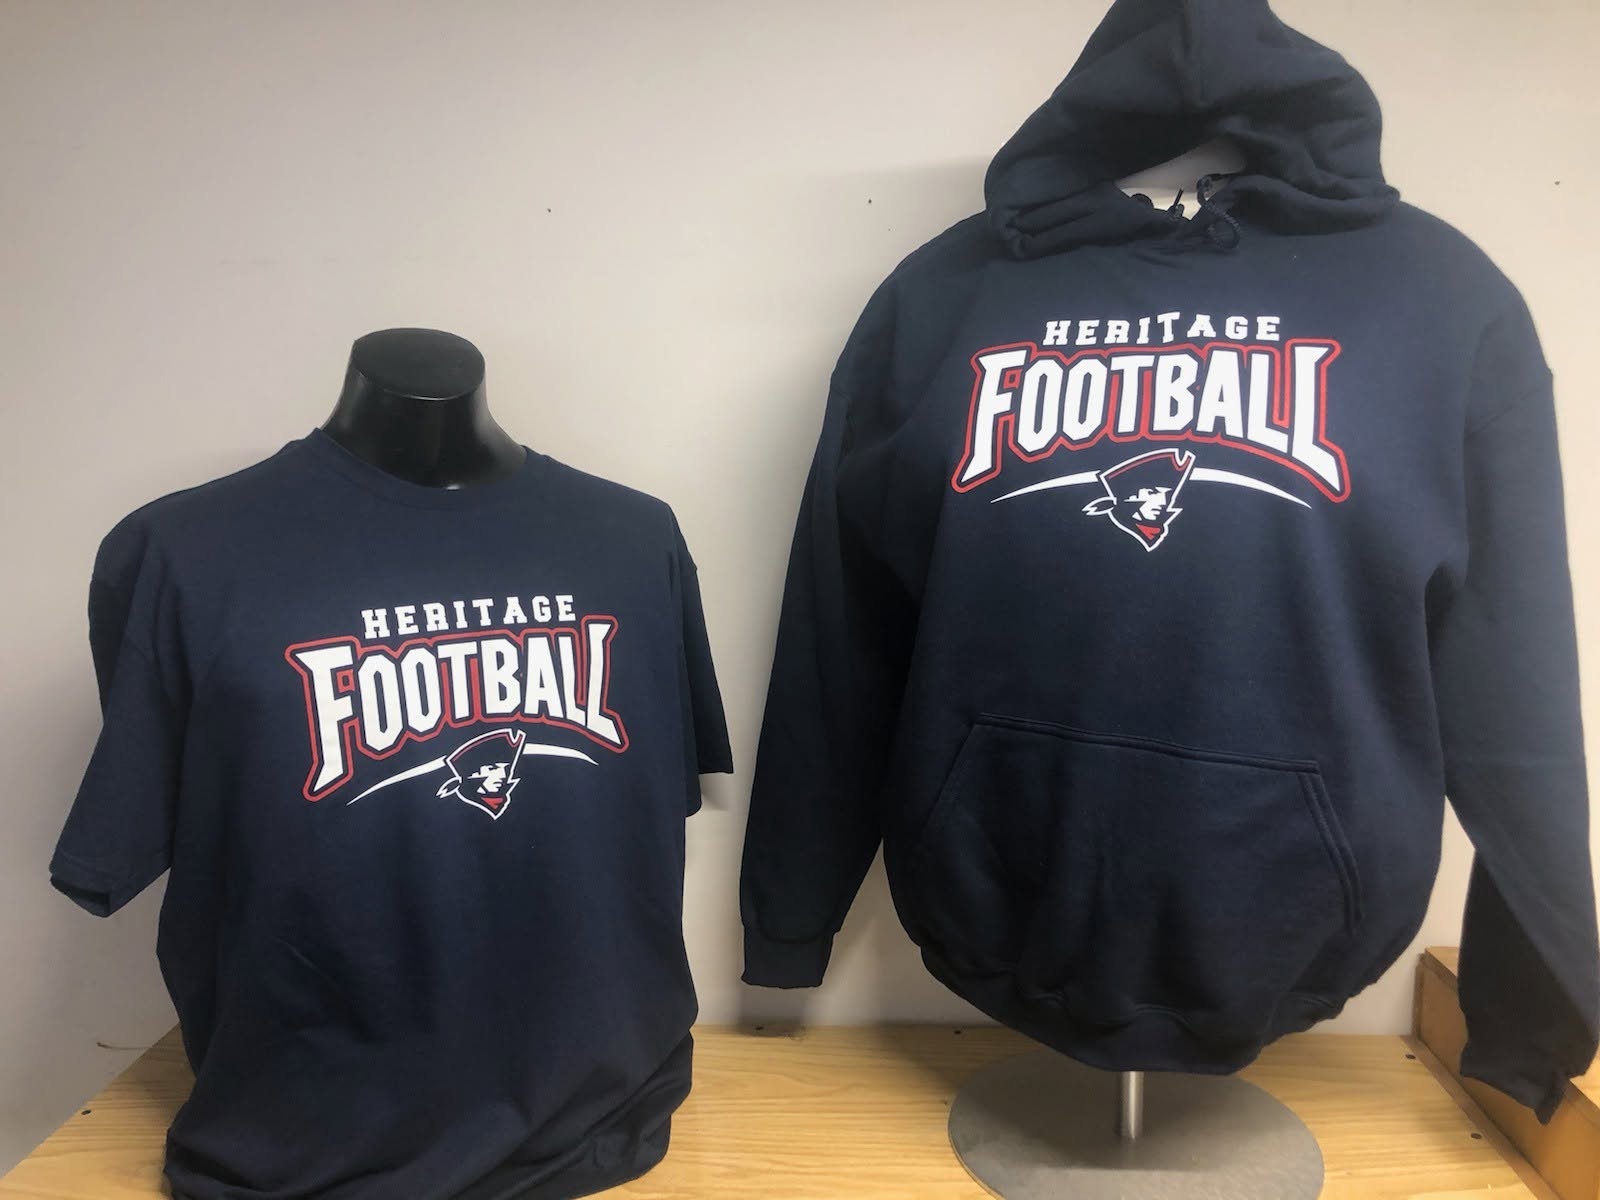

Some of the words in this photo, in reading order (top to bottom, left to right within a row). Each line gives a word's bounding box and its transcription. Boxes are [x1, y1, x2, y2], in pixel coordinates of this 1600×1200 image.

[1042, 311, 1281, 346] HERITAGE
[959, 345, 1341, 493] FOOTBALL
[360, 594, 577, 640] HERITAGE
[294, 622, 623, 794] FOOTBALL
